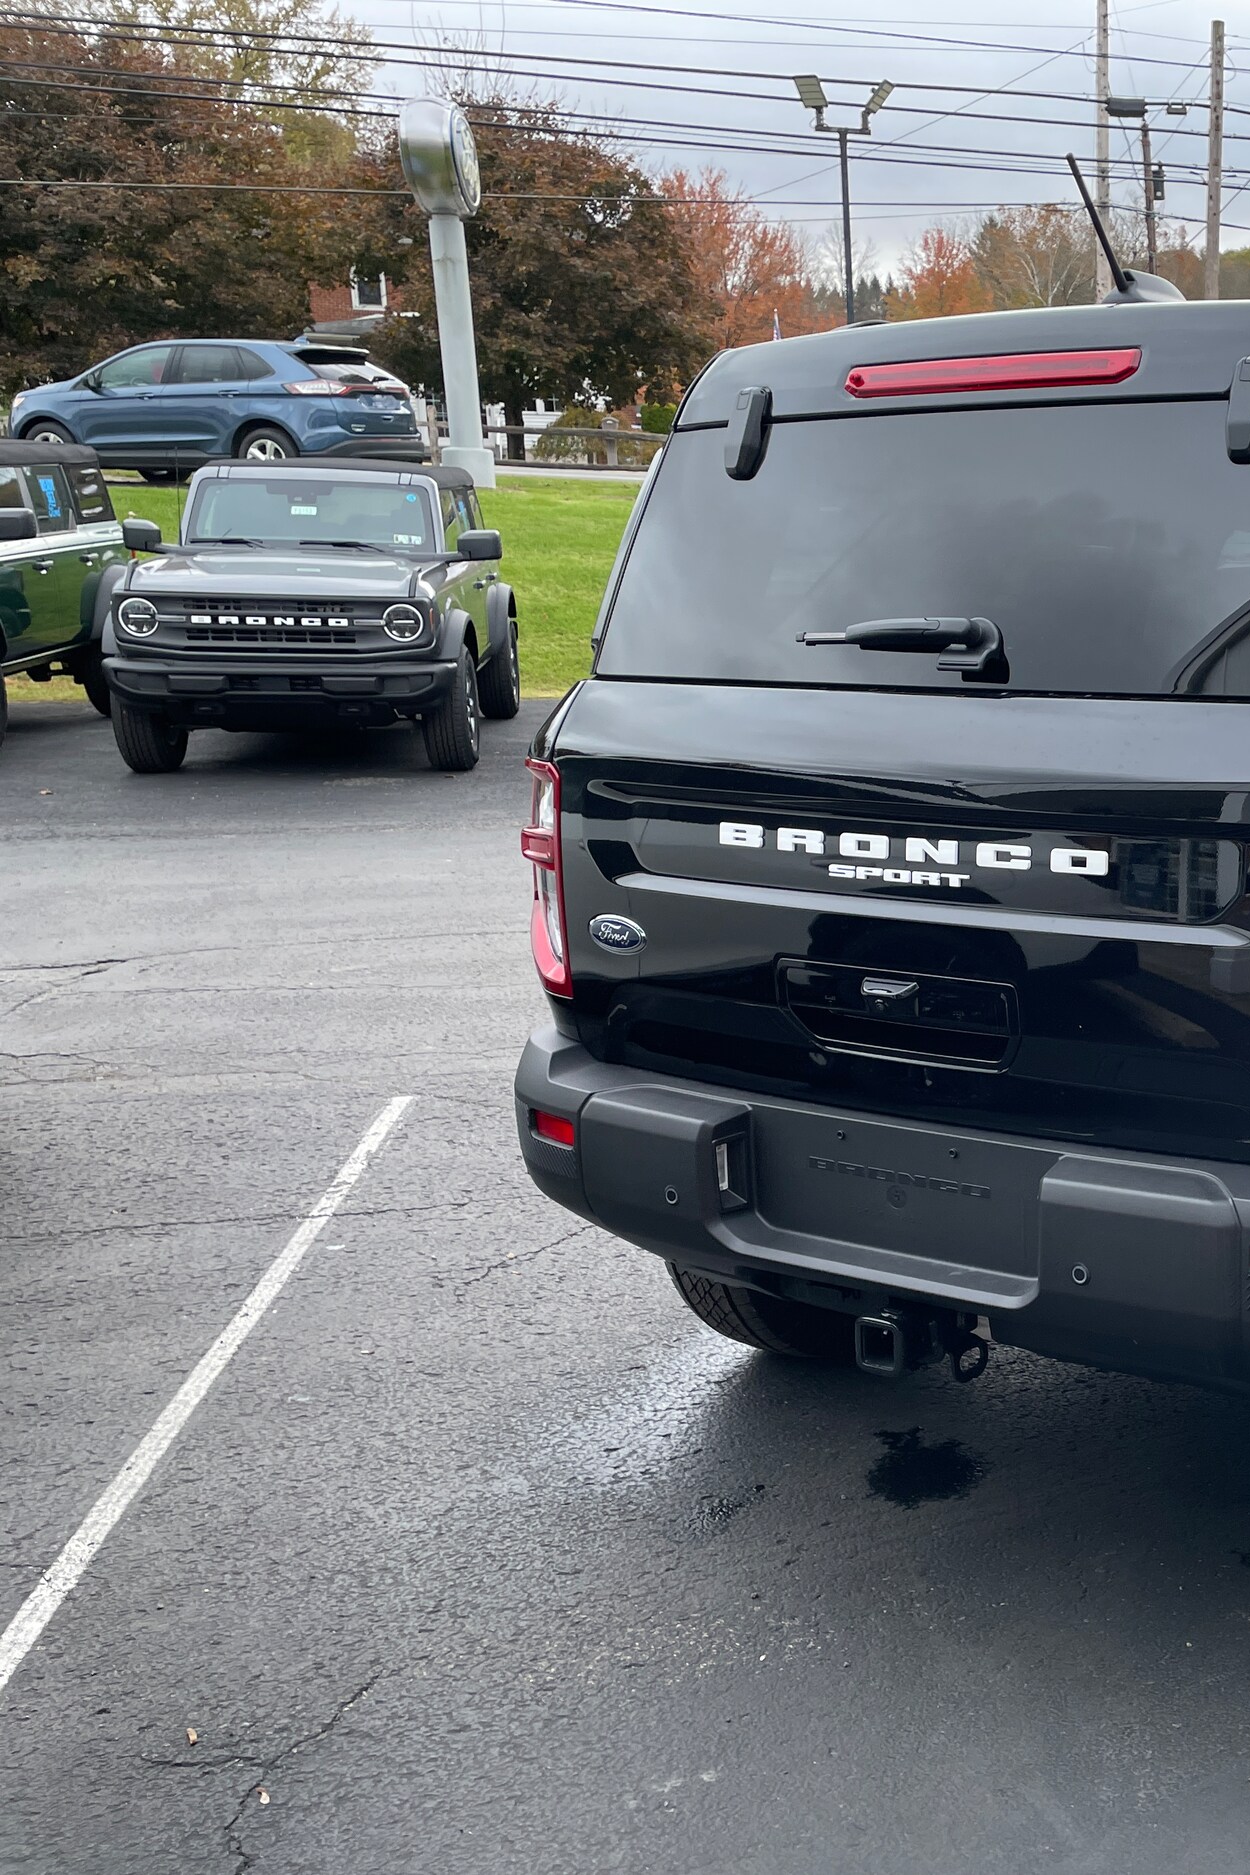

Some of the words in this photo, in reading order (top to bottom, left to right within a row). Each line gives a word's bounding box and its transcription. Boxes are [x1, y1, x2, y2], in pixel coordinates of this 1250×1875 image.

[190, 615, 349, 627] BRONCO
[719, 821, 1109, 876] BRONCO
[828, 863, 971, 888] SPORT
[598, 921, 630, 941] Ford
[808, 1155, 992, 1199] BRONCO
